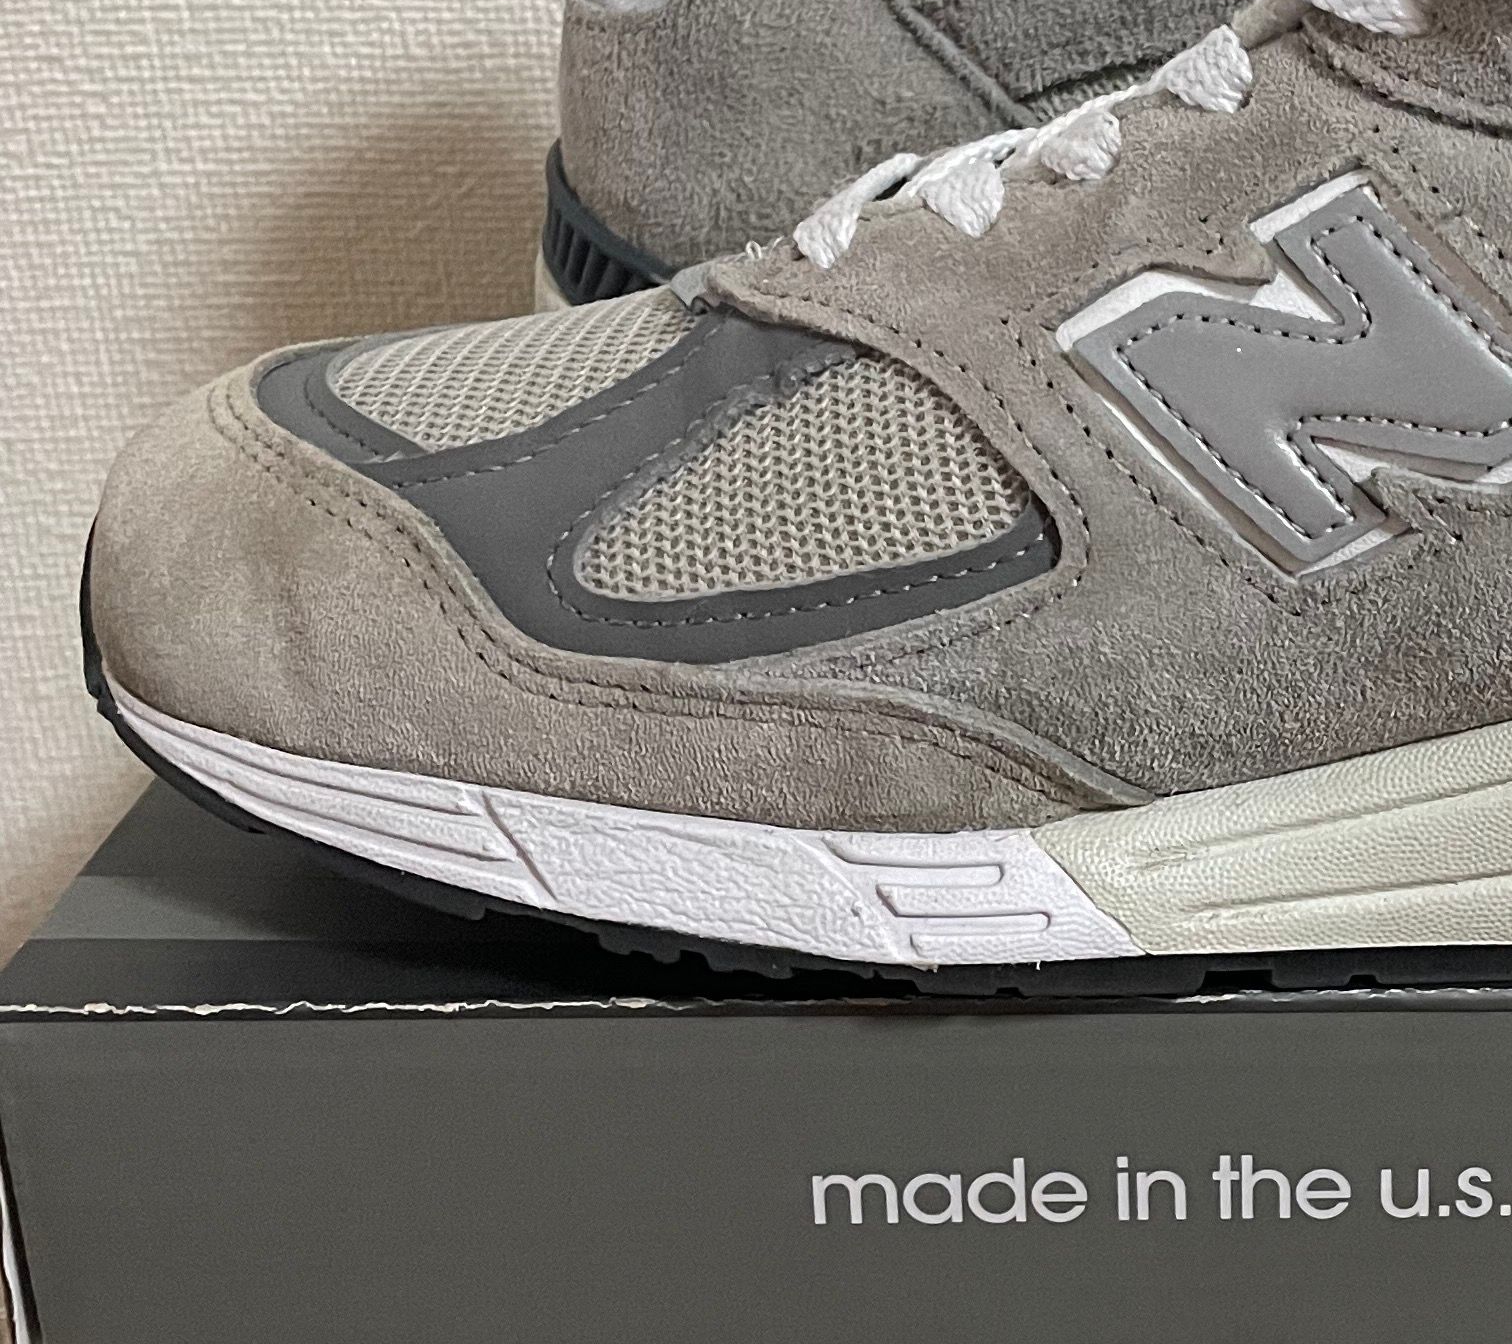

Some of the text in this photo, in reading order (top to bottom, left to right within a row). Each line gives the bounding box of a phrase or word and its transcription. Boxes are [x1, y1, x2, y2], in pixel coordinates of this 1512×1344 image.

[811, 1156, 1089, 1226] made
[1115, 1155, 1188, 1222] in
[1210, 1153, 1353, 1221] the
[1379, 1165, 1512, 1220] u.s.
